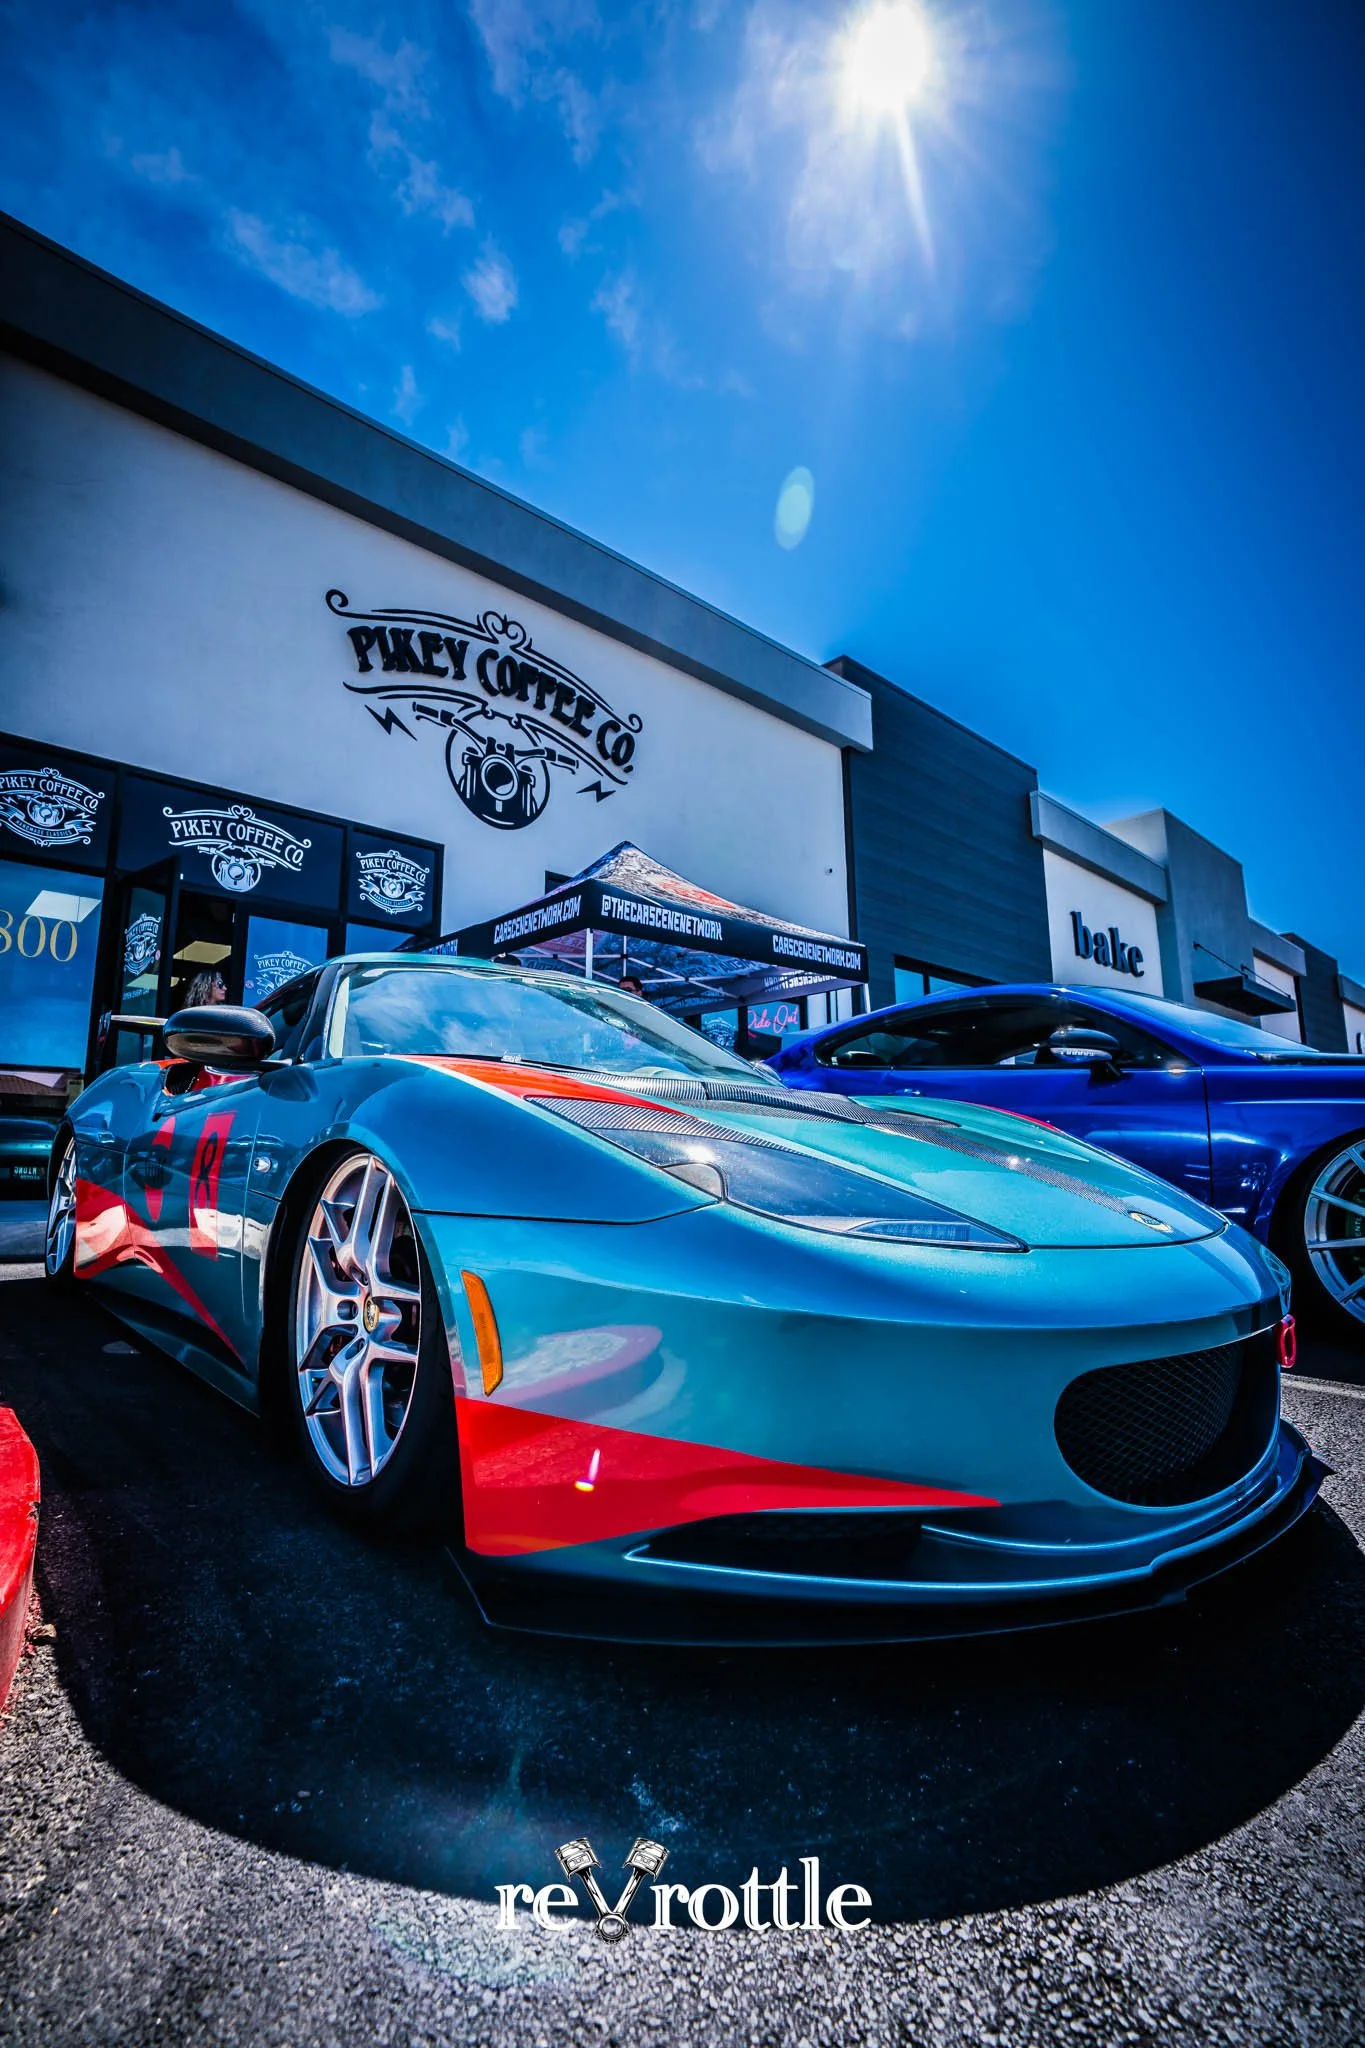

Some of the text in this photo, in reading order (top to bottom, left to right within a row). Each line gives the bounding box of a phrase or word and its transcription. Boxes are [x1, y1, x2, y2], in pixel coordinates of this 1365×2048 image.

[347, 626, 637, 774] PIKEY COFFEE CO.
[0, 776, 36, 789] PIKEY
[40, 779, 84, 802] COFFEE
[170, 819, 304, 866] PIKEY COFFEE CO.
[360, 858, 386, 870] PIKEY
[386, 859, 416, 877] COFFEE
[493, 895, 582, 945] CARSCENENETWORK.COM
[601, 894, 723, 941] @THECARSCENENETWORK
[257, 959, 280, 970] PIKEY
[772, 934, 862, 971] CARSCENENETWORK.COM
[1069, 910, 1145, 978] bake
